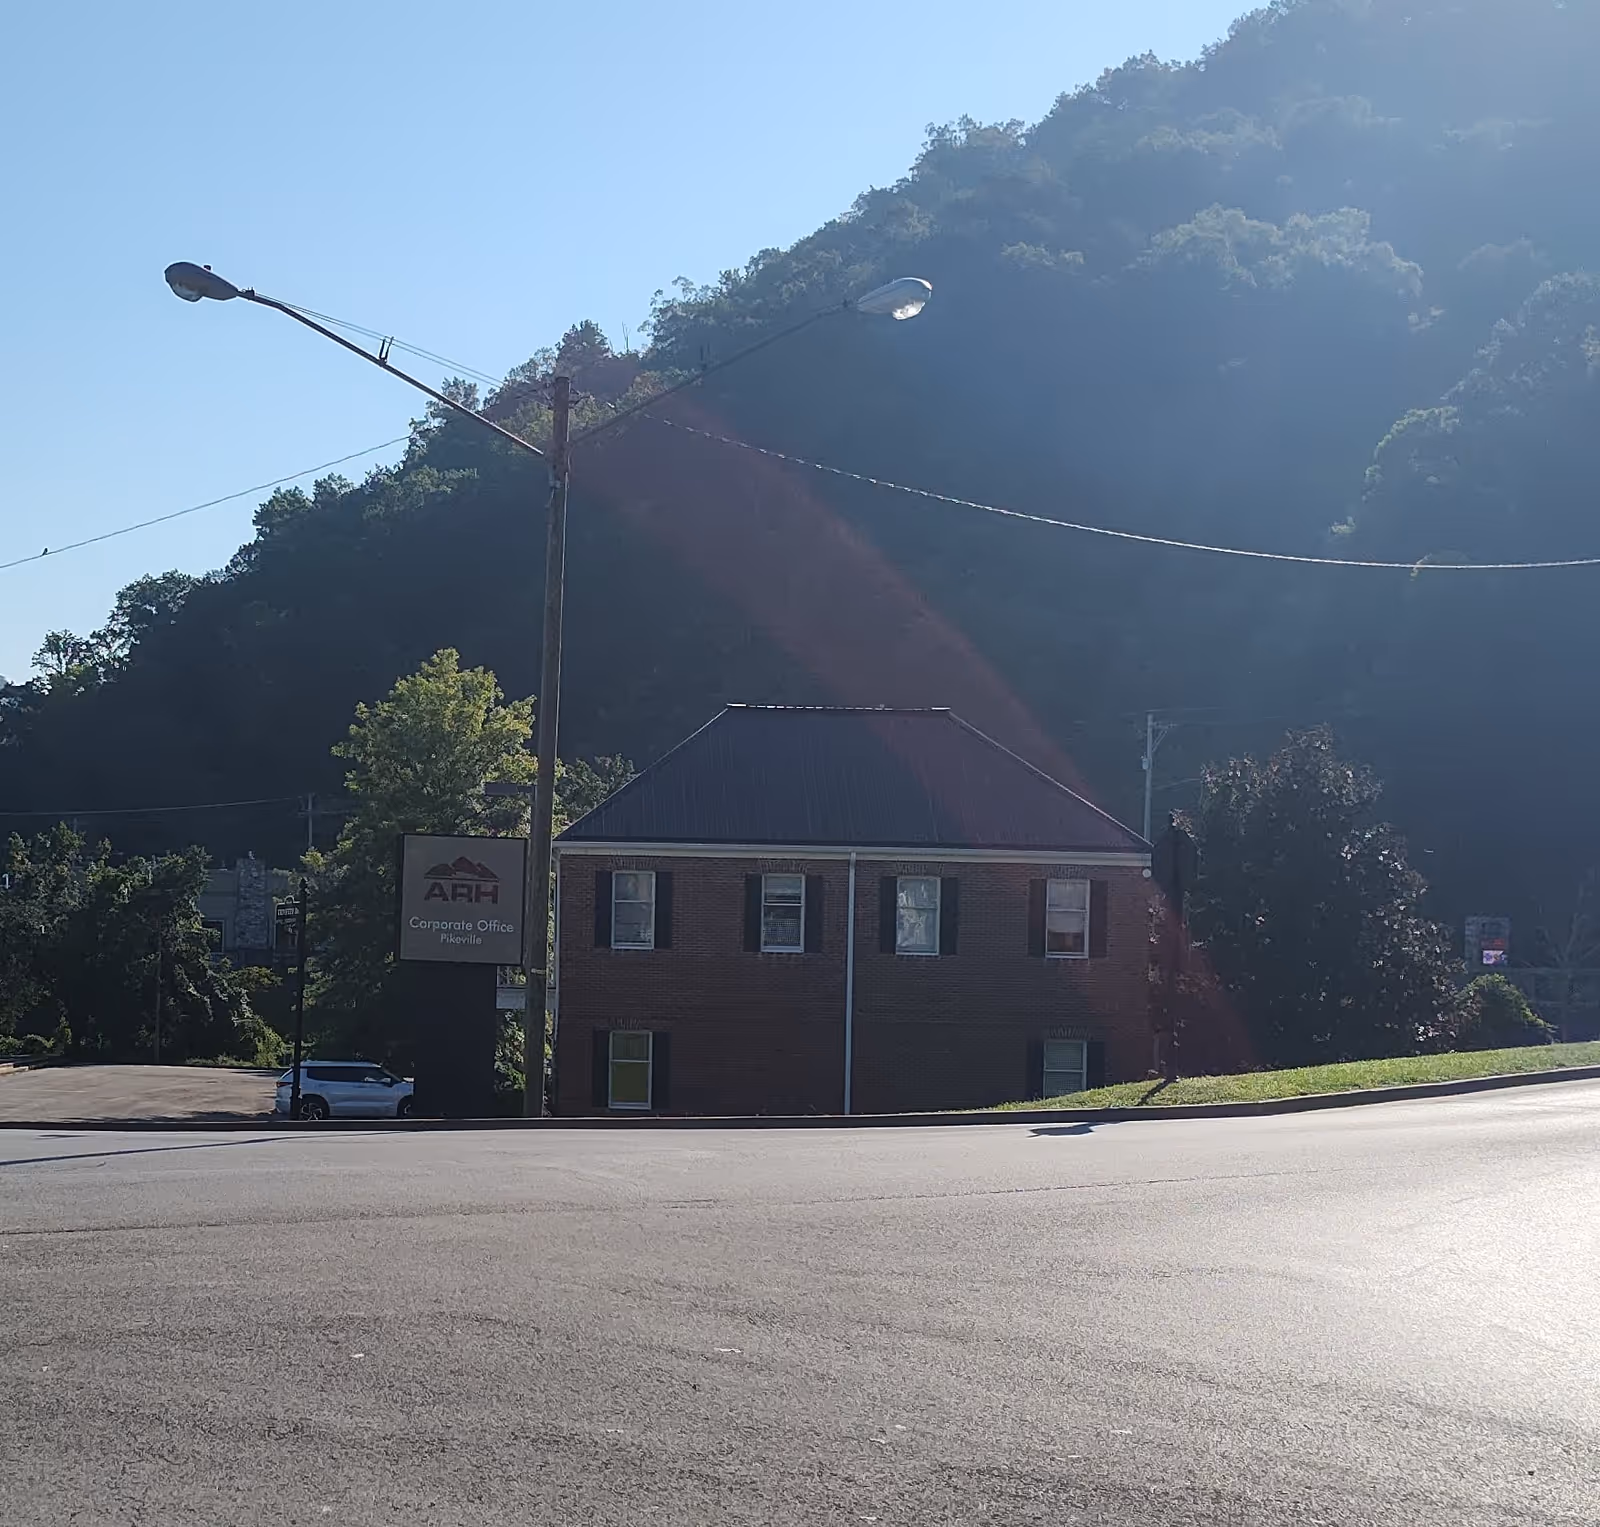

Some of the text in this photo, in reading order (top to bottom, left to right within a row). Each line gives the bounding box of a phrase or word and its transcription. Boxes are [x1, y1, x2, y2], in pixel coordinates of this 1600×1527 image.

[424, 881, 499, 904] ARH
[409, 916, 514, 933] Corporate Office
[440, 934, 482, 945] Pikeville
